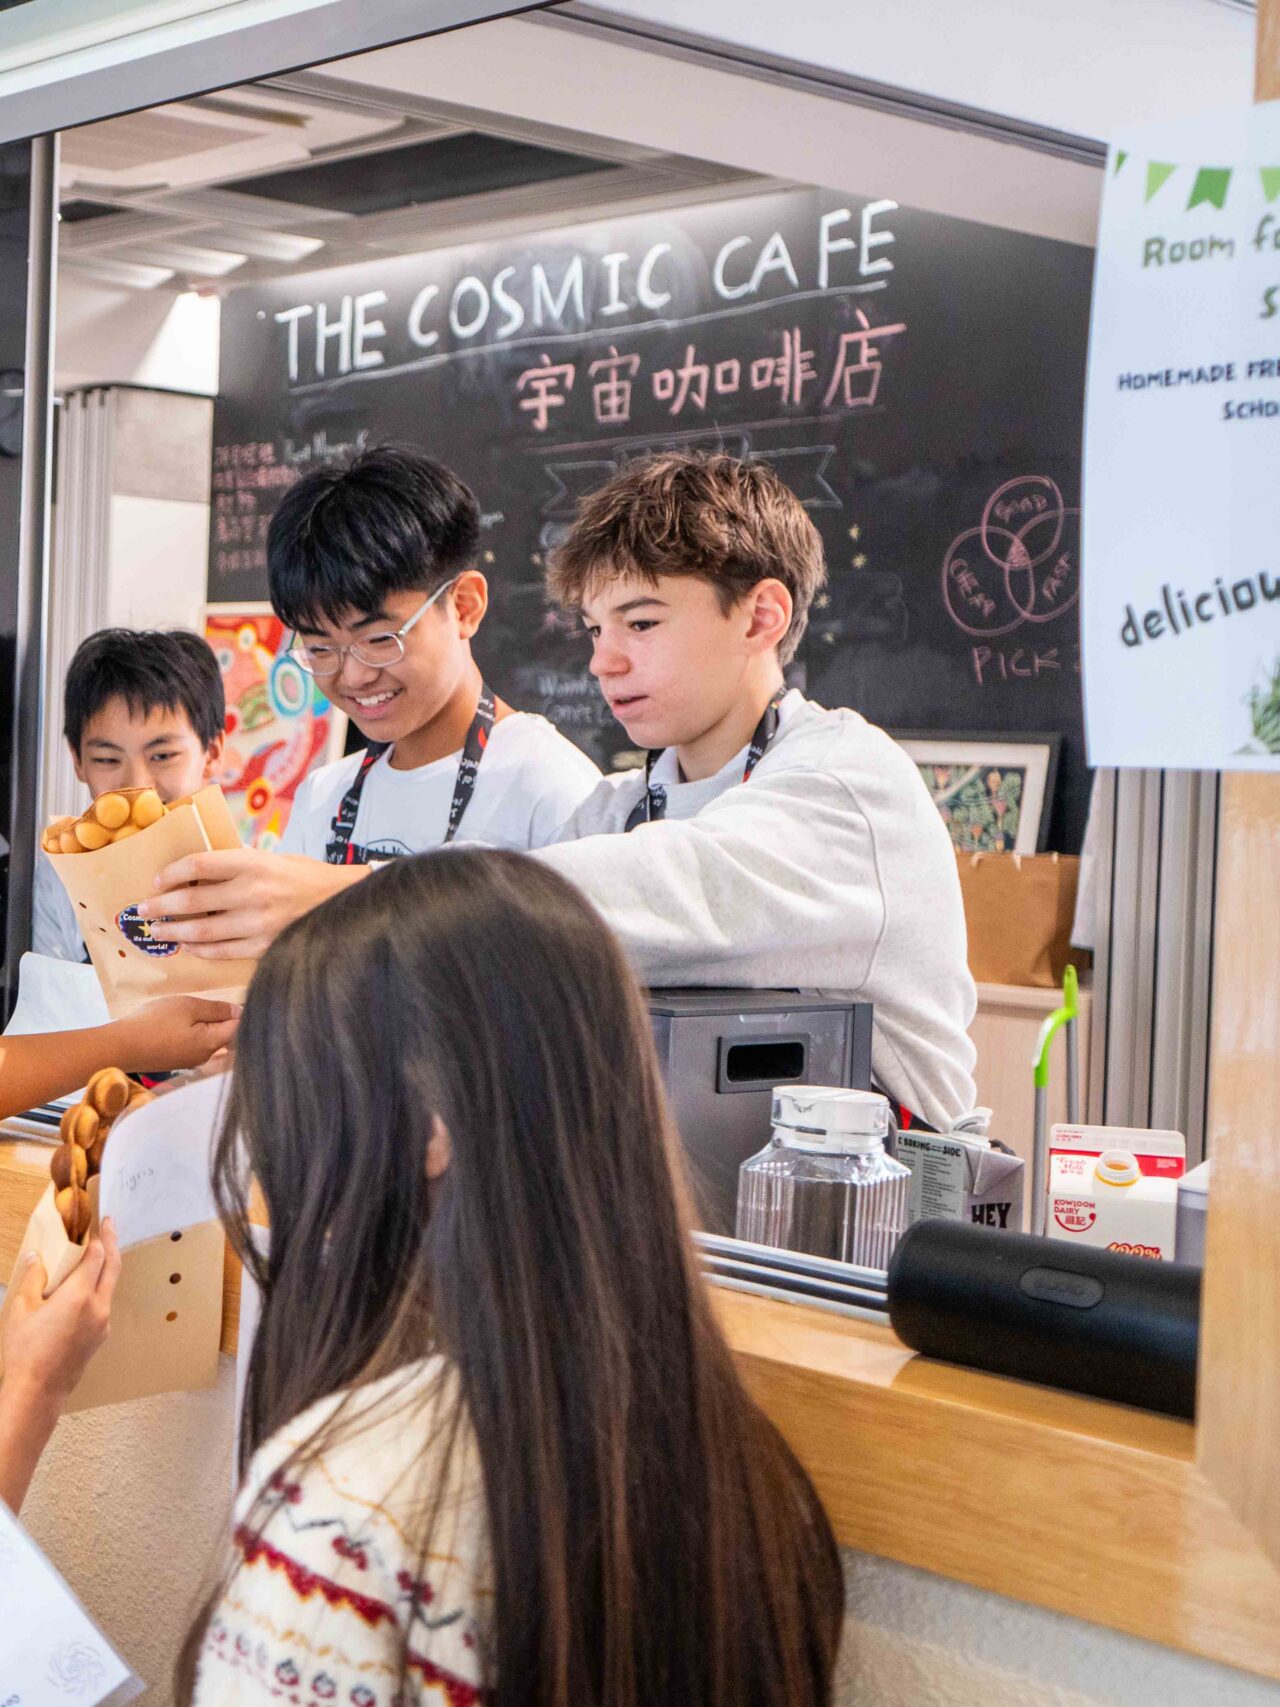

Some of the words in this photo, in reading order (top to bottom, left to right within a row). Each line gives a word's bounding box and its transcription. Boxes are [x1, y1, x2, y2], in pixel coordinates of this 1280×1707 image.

[1142, 234, 1235, 268] Room
[275, 290, 388, 381] THE
[407, 243, 673, 348] COSMIC
[712, 200, 899, 300] CAFE
[516, 308, 907, 431] 宇宙咖啡店
[1118, 362, 1235, 390] HOMEMADE
[972, 645, 1061, 686] PICK
[904, 1138, 931, 1151] BORING
[942, 1145, 961, 1157] SIDE
[971, 1202, 1012, 1229] HEY
[1054, 1198, 1096, 1209] KOWLOON
[1054, 1206, 1080, 1215] DAIRY
